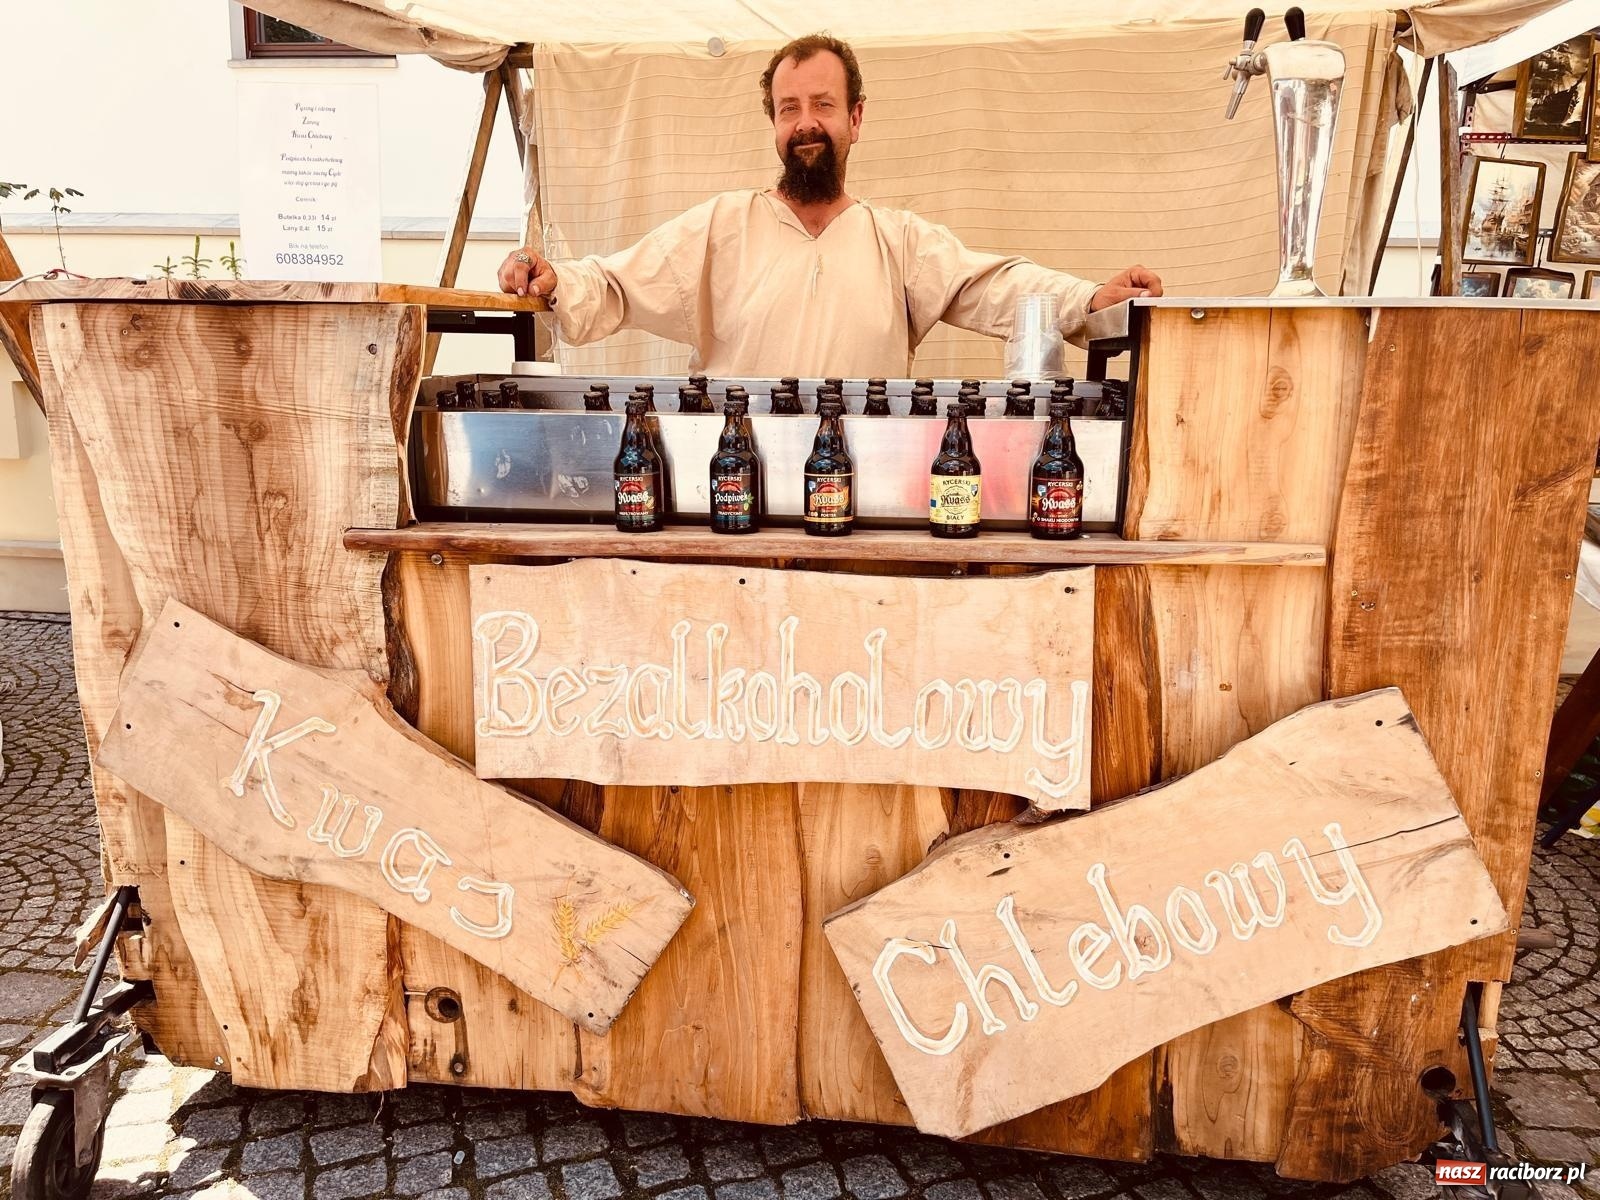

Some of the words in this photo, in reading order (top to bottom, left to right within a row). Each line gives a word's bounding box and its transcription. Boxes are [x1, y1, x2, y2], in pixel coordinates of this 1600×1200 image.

[321, 213, 330, 221] 14
[317, 224, 326, 232] 15
[275, 253, 344, 266] 608384952
[714, 491, 749, 505] Podpiwek
[871, 821, 1384, 1057] Chlebowy
